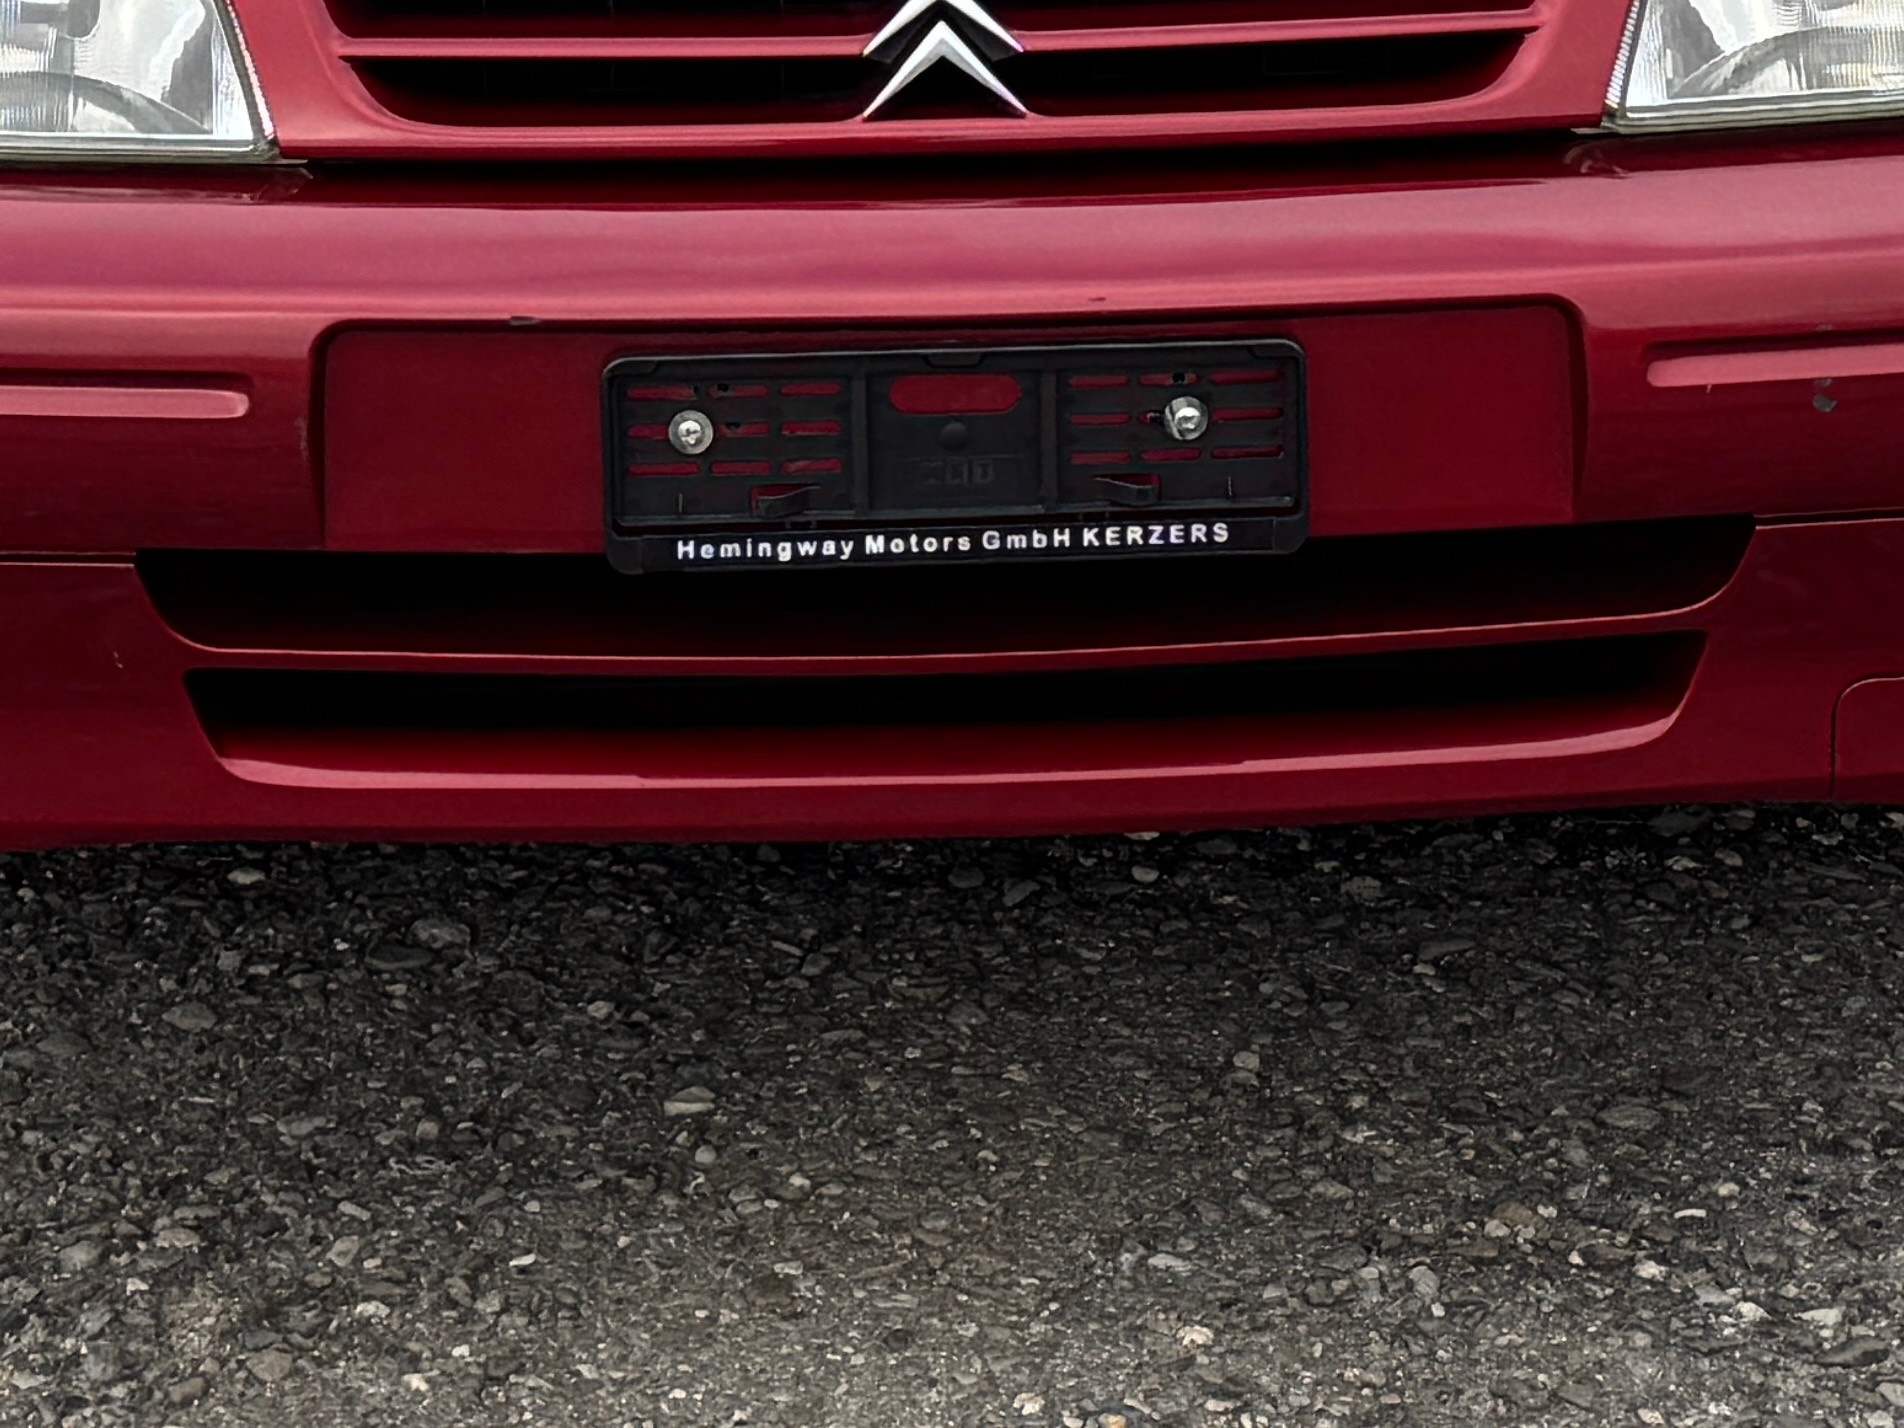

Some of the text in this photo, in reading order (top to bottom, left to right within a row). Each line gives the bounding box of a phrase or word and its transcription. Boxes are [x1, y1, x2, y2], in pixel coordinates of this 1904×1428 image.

[677, 522, 1229, 562] Hemingway Motors GmbH KERZERS
